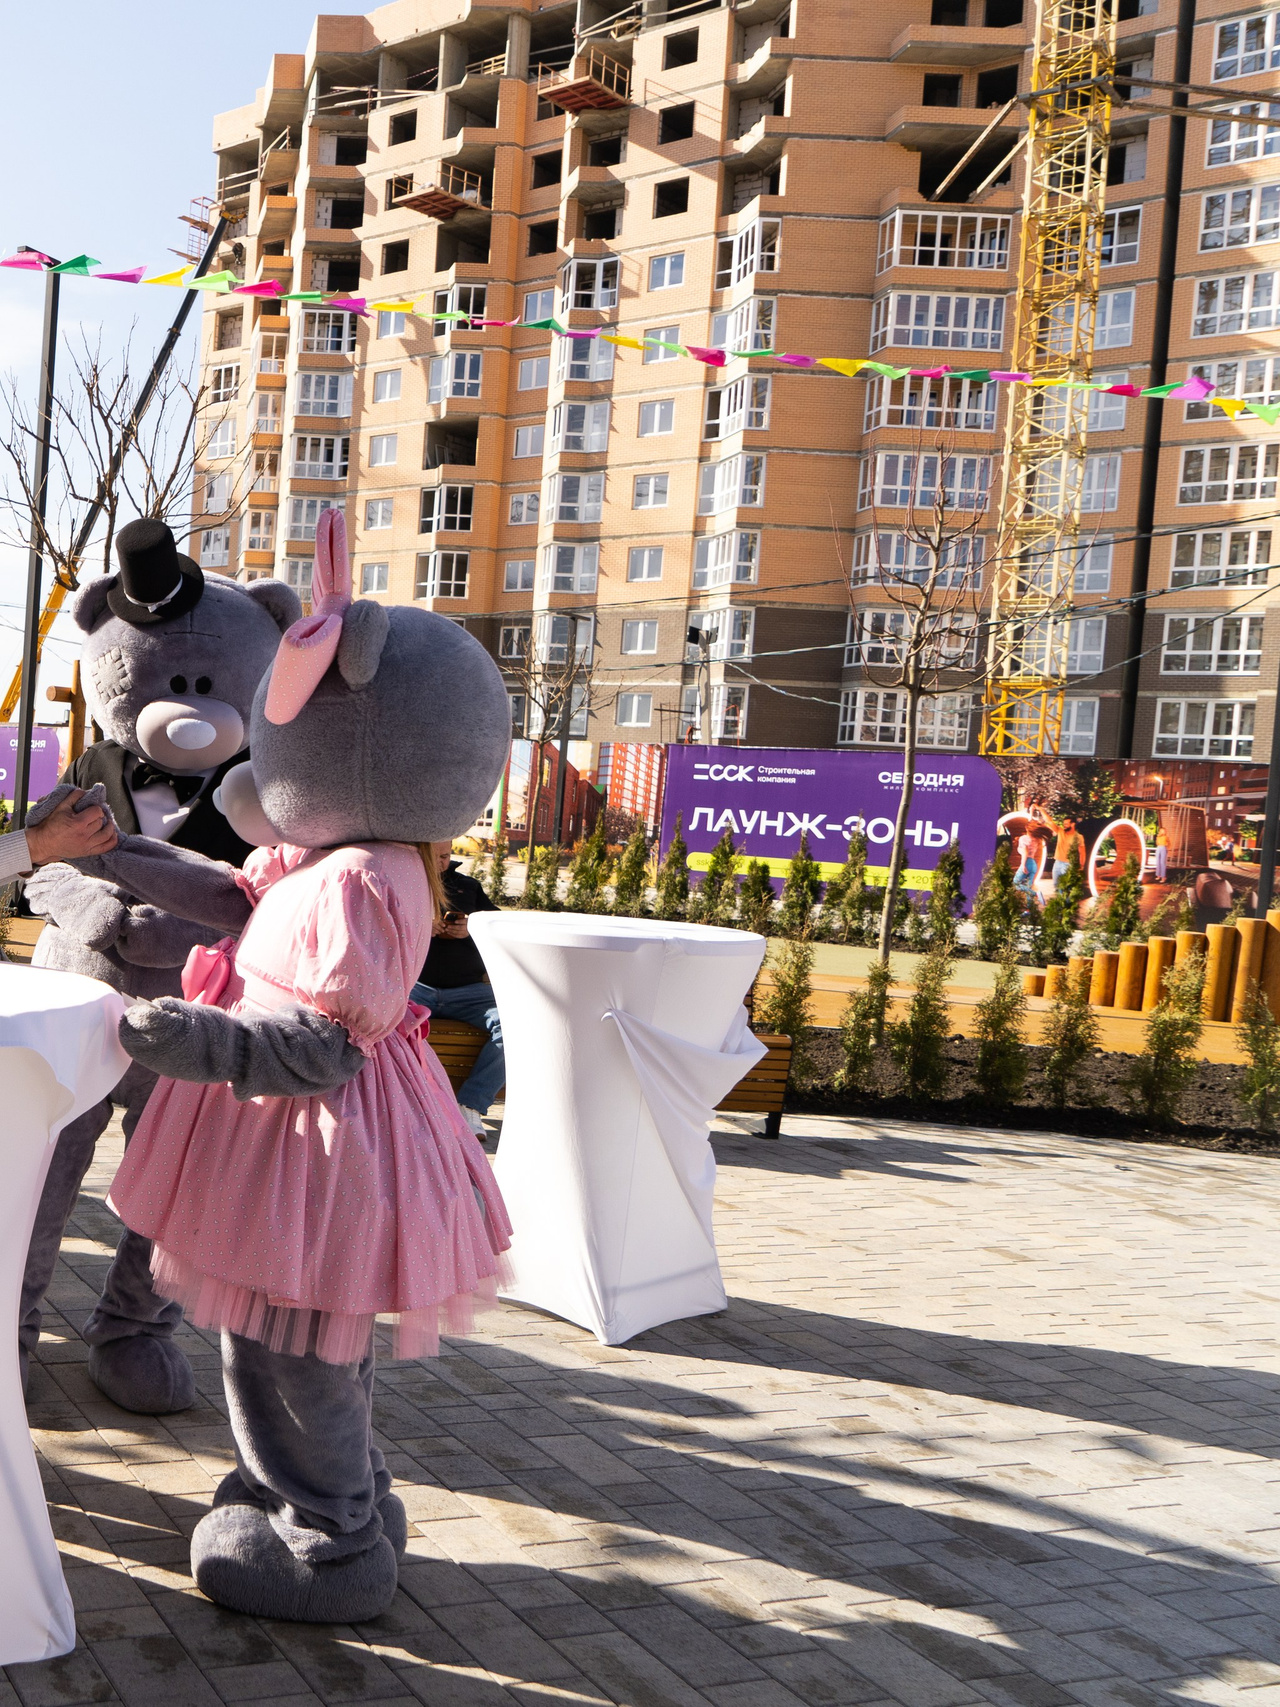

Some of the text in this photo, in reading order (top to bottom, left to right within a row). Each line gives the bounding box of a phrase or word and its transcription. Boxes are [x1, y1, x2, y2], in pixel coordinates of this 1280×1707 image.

[757, 765, 816, 776] Строительная
[757, 775, 796, 784] компания
[878, 771, 965, 787] СЕОДНЯ
[688, 806, 960, 847] ЛАУНЖ-ЗОНЫ
